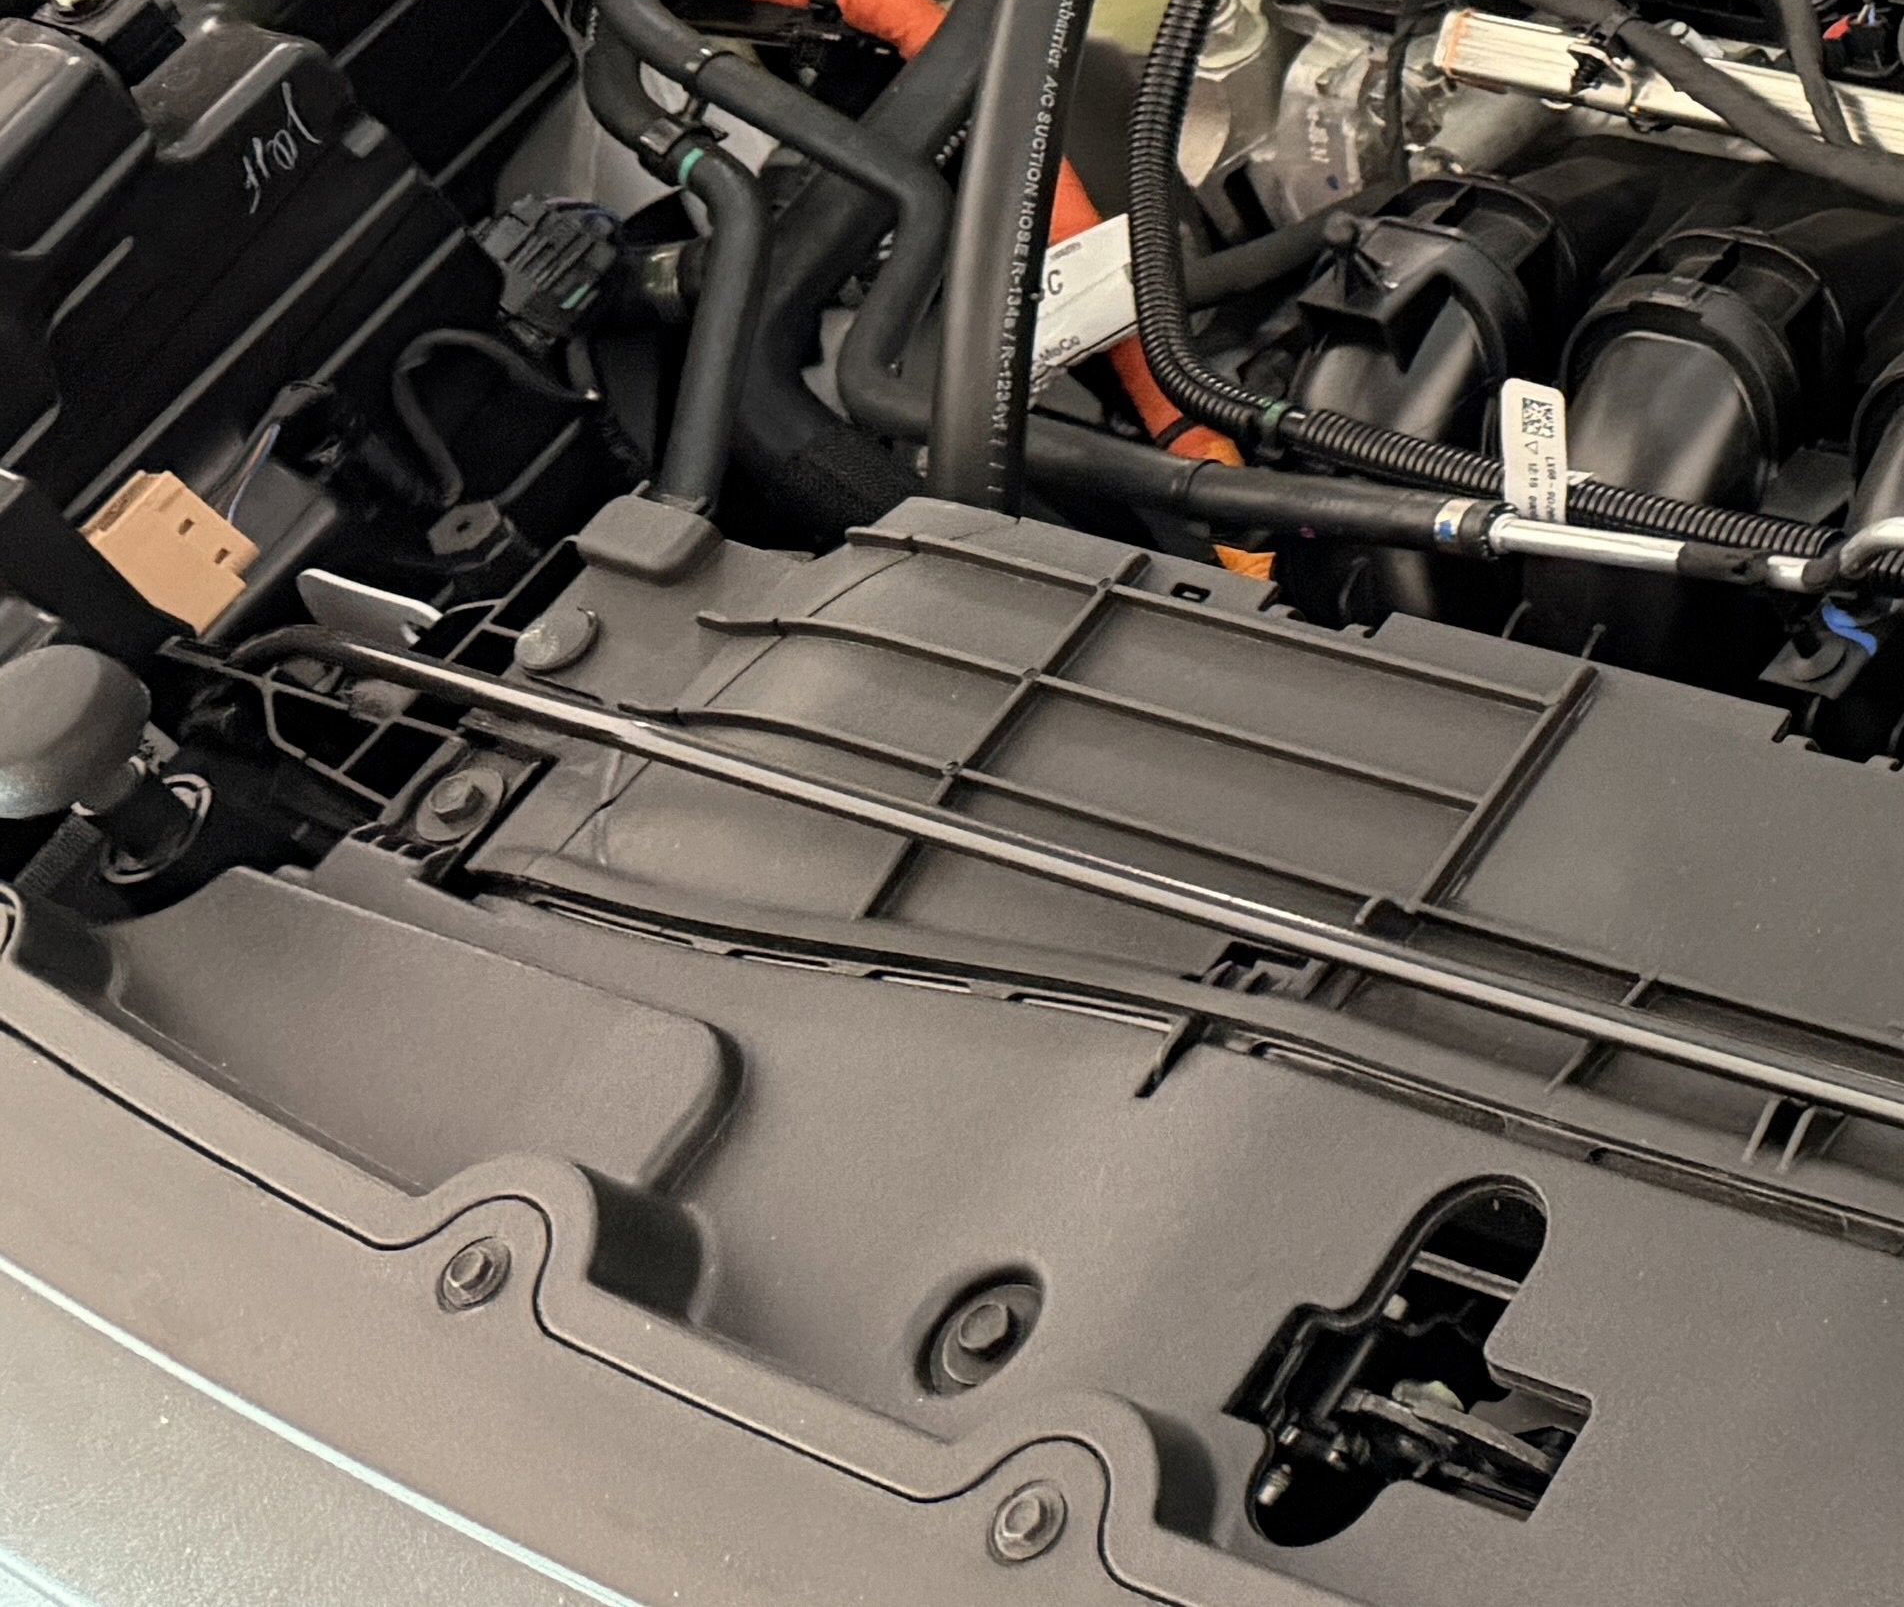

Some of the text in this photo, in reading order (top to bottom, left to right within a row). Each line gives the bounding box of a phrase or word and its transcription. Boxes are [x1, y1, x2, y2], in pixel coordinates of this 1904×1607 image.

[1039, 74, 1060, 108] A/C
[1021, 111, 1052, 198] SUCTION
[1014, 200, 1033, 256] HOSE
